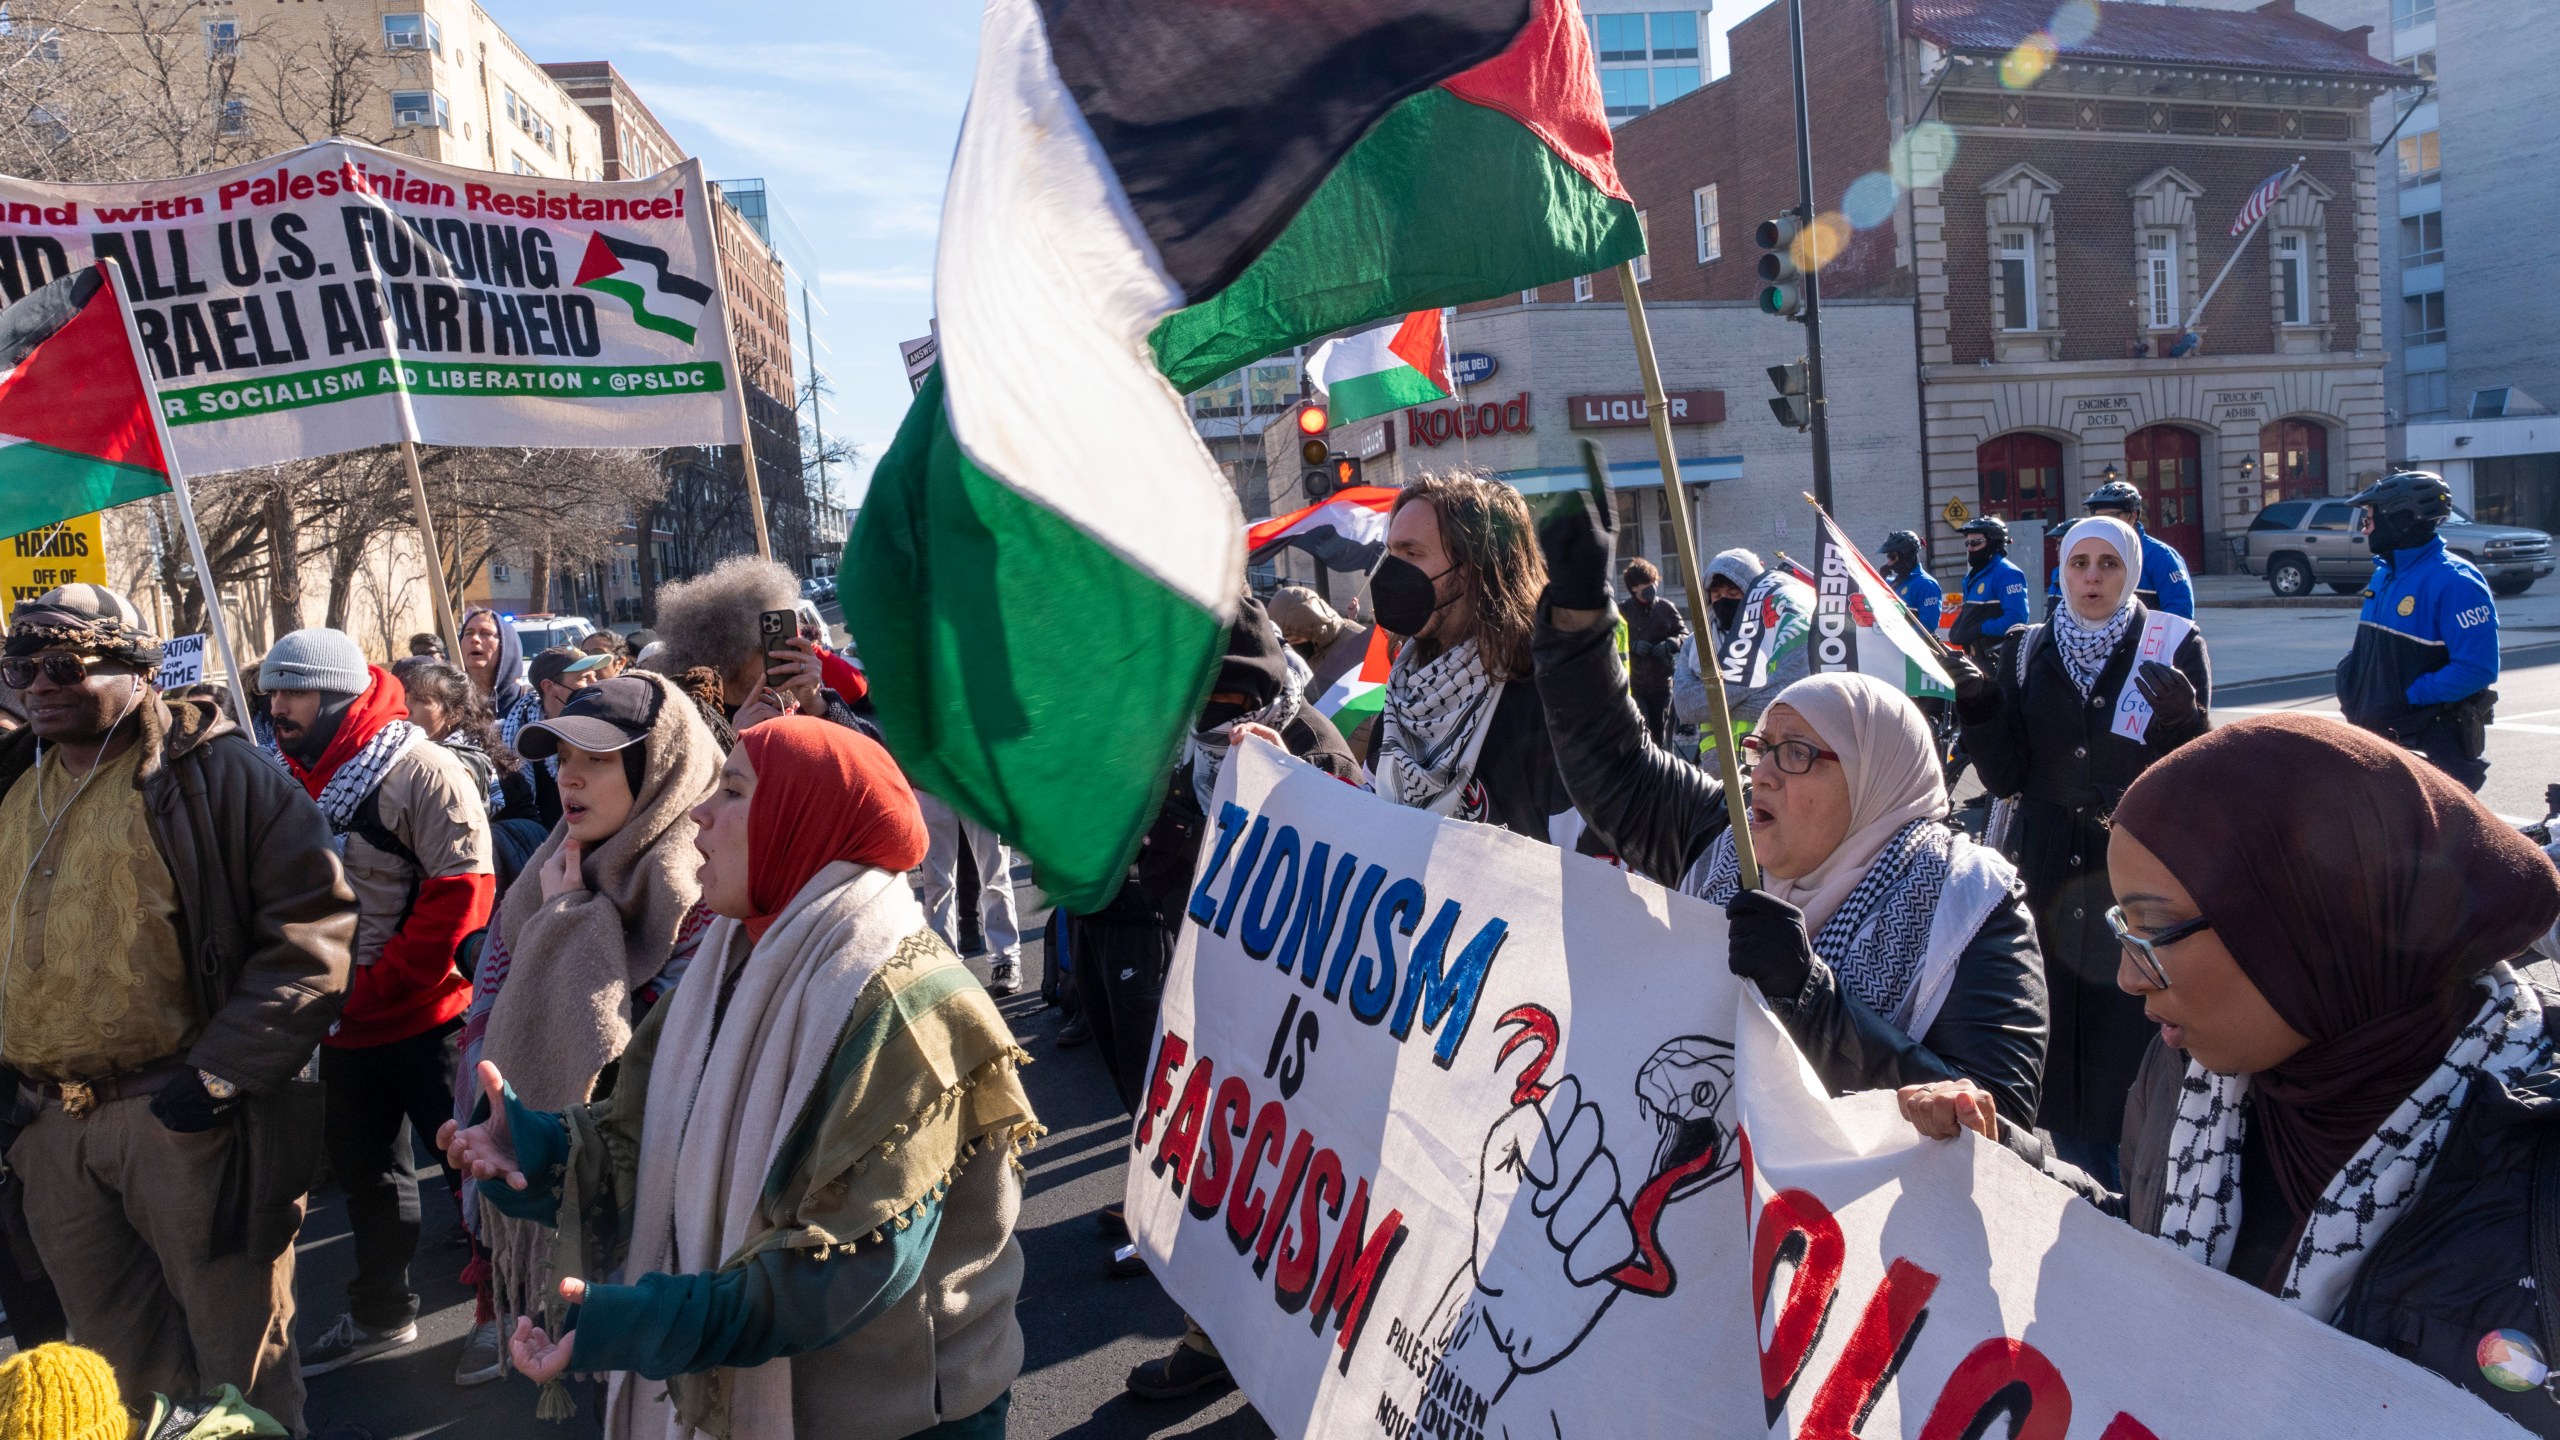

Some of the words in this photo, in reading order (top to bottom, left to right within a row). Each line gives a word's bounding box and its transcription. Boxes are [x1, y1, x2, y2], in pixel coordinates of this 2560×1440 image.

[0, 203, 78, 226] nd
[95, 196, 203, 224] with
[219, 162, 455, 211] Palestinian
[464, 183, 685, 221] Resistance!
[0, 236, 70, 308] ND
[218, 213, 336, 288] U.S.
[341, 205, 559, 290] FUNDING
[134, 290, 310, 380] RAELI
[319, 281, 601, 358] APARTHEID
[910, 342, 934, 364] ANSWE
[1471, 357, 1489, 370] DELI
[164, 399, 189, 418] R
[200, 371, 365, 412] SOCIALISM
[378, 367, 418, 388] AD
[427, 371, 583, 389] LIBERATION
[609, 370, 706, 391] @PSLDC
[2078, 399, 2112, 410] ENGINE
[2217, 392, 2248, 403] TRUCK
[1585, 398, 1688, 422] LIQUR
[15, 532, 89, 558] HANDS
[33, 569, 57, 584] OFF
[60, 569, 77, 584] OF
[2006, 584, 2023, 595] USCP
[2456, 605, 2491, 629] USCP
[162, 635, 203, 658] RATION
[1188, 800, 1509, 1071] ZIONISM
[1263, 993, 1319, 1100] IS
[1135, 1030, 1410, 1378] FASCISM
[1386, 1316, 1489, 1430] PALESTINIAN
